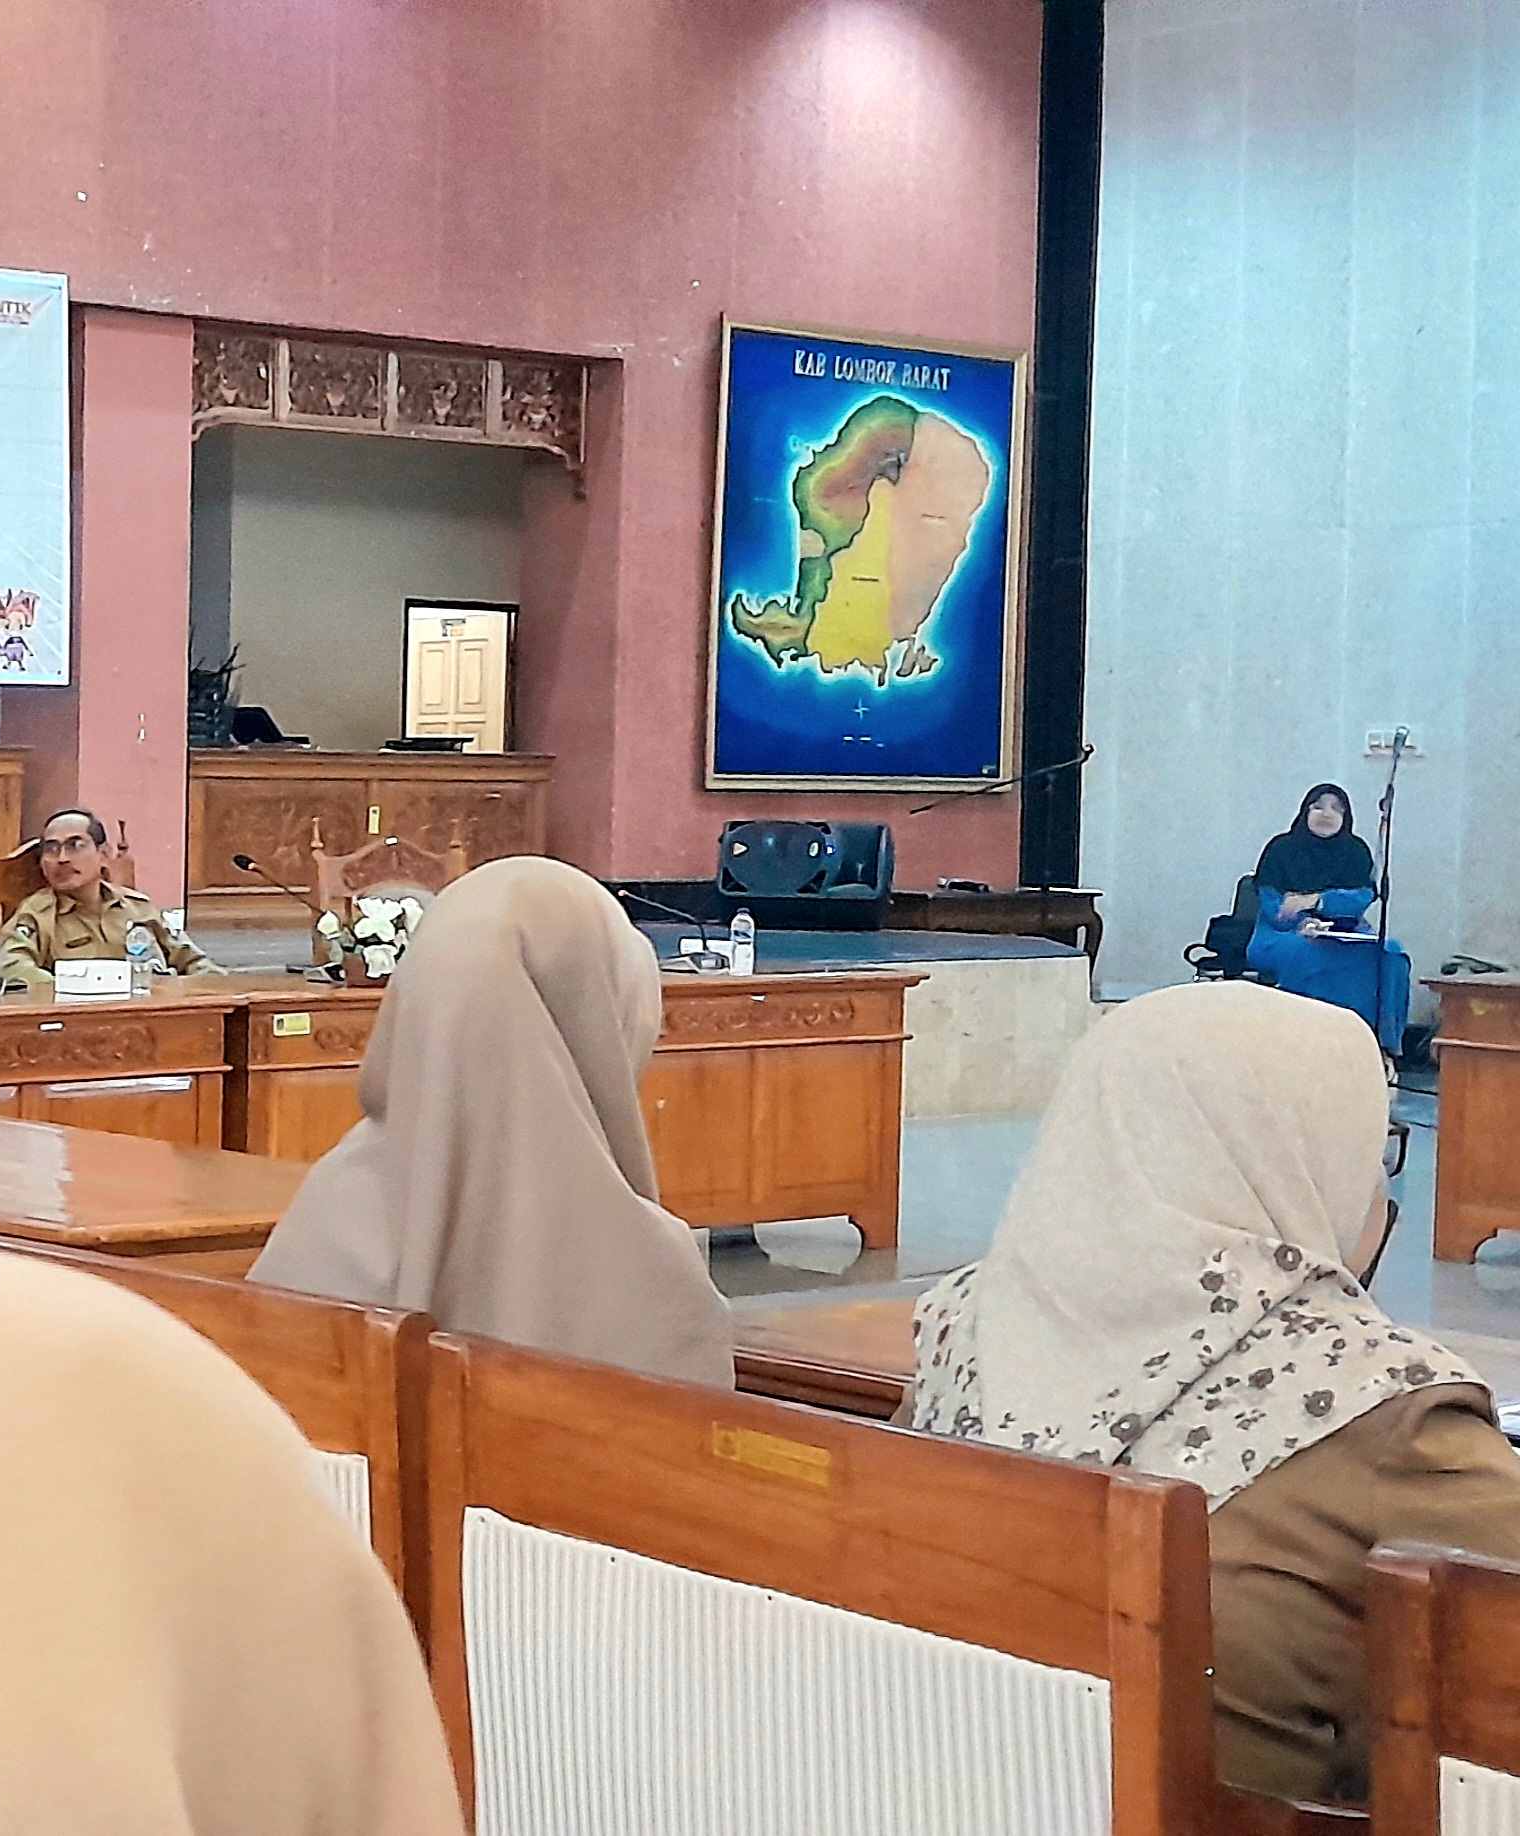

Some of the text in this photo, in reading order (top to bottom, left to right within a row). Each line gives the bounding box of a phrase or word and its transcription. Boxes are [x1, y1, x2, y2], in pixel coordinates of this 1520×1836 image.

[794, 349, 951, 391] KAB LOMBOK BARAT
